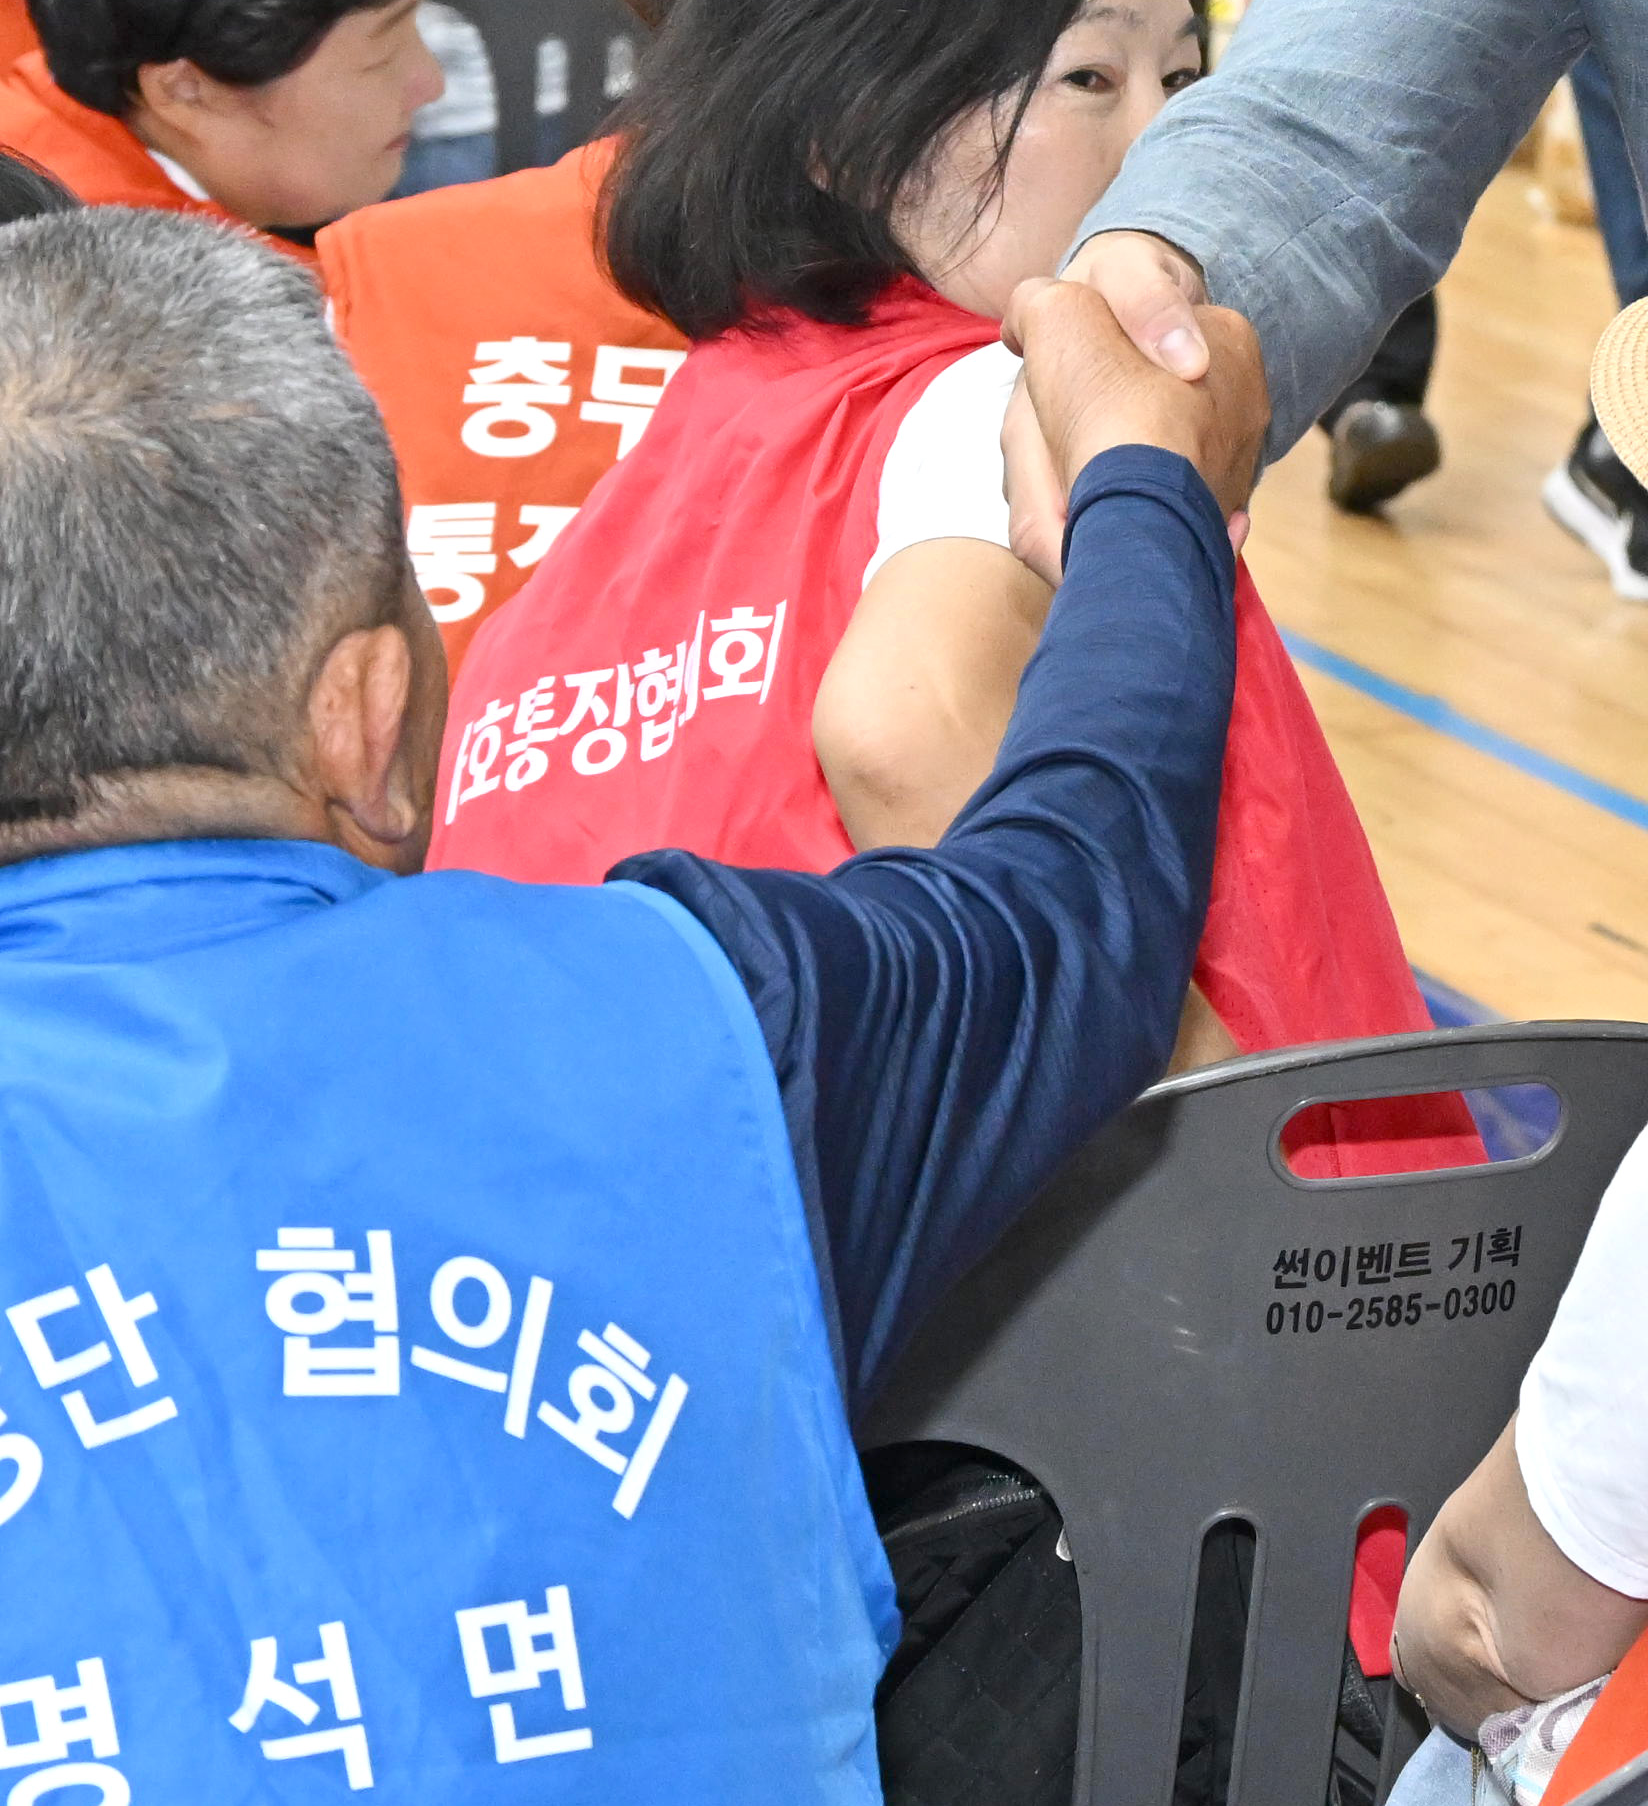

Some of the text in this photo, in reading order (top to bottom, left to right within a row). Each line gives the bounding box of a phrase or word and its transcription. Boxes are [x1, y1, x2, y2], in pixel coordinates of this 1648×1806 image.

[1272, 1225, 1523, 1289] 썬이벤트 기획
[1266, 1279, 1516, 1335] 010-2585-0300
[256, 1227, 689, 1519] 협의회
